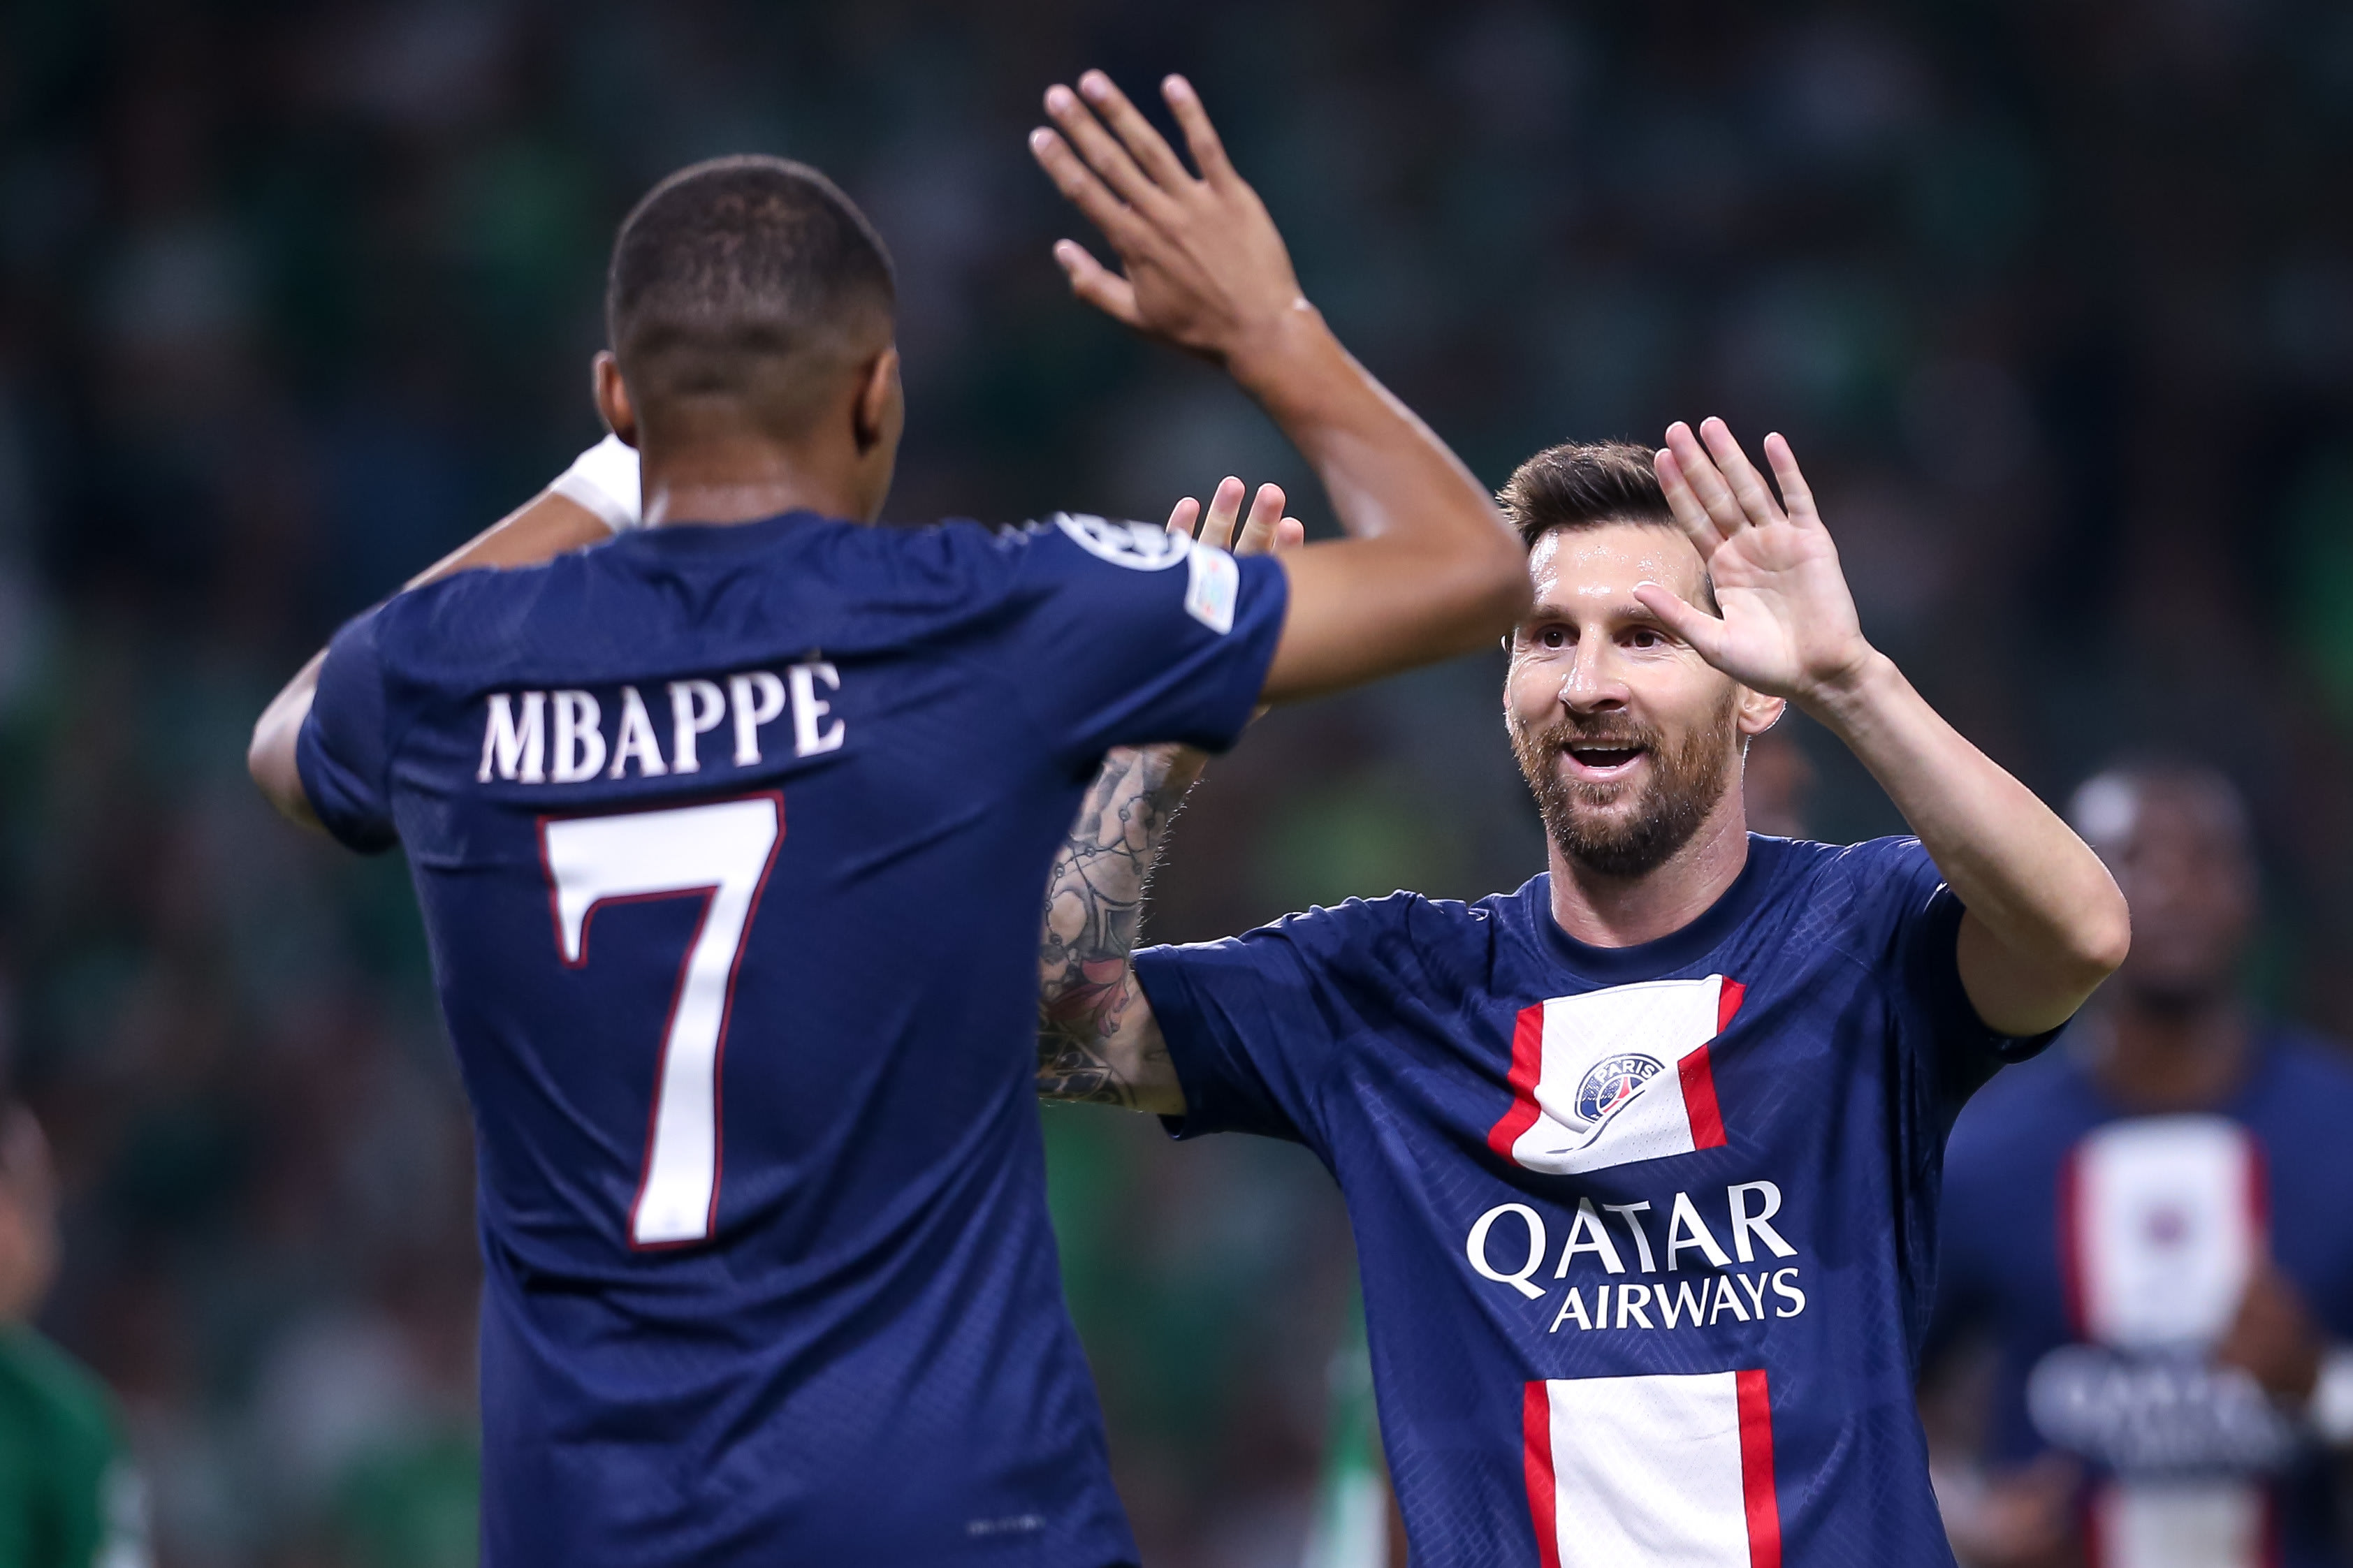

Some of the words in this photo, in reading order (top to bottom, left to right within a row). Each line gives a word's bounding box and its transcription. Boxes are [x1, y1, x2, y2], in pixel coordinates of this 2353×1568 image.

[537, 790, 787, 1251] 7
[1594, 1059, 1655, 1084] PARIS
[1466, 1180, 1798, 1300] QATAR
[1548, 1268, 1806, 1333] AIRWAYS
